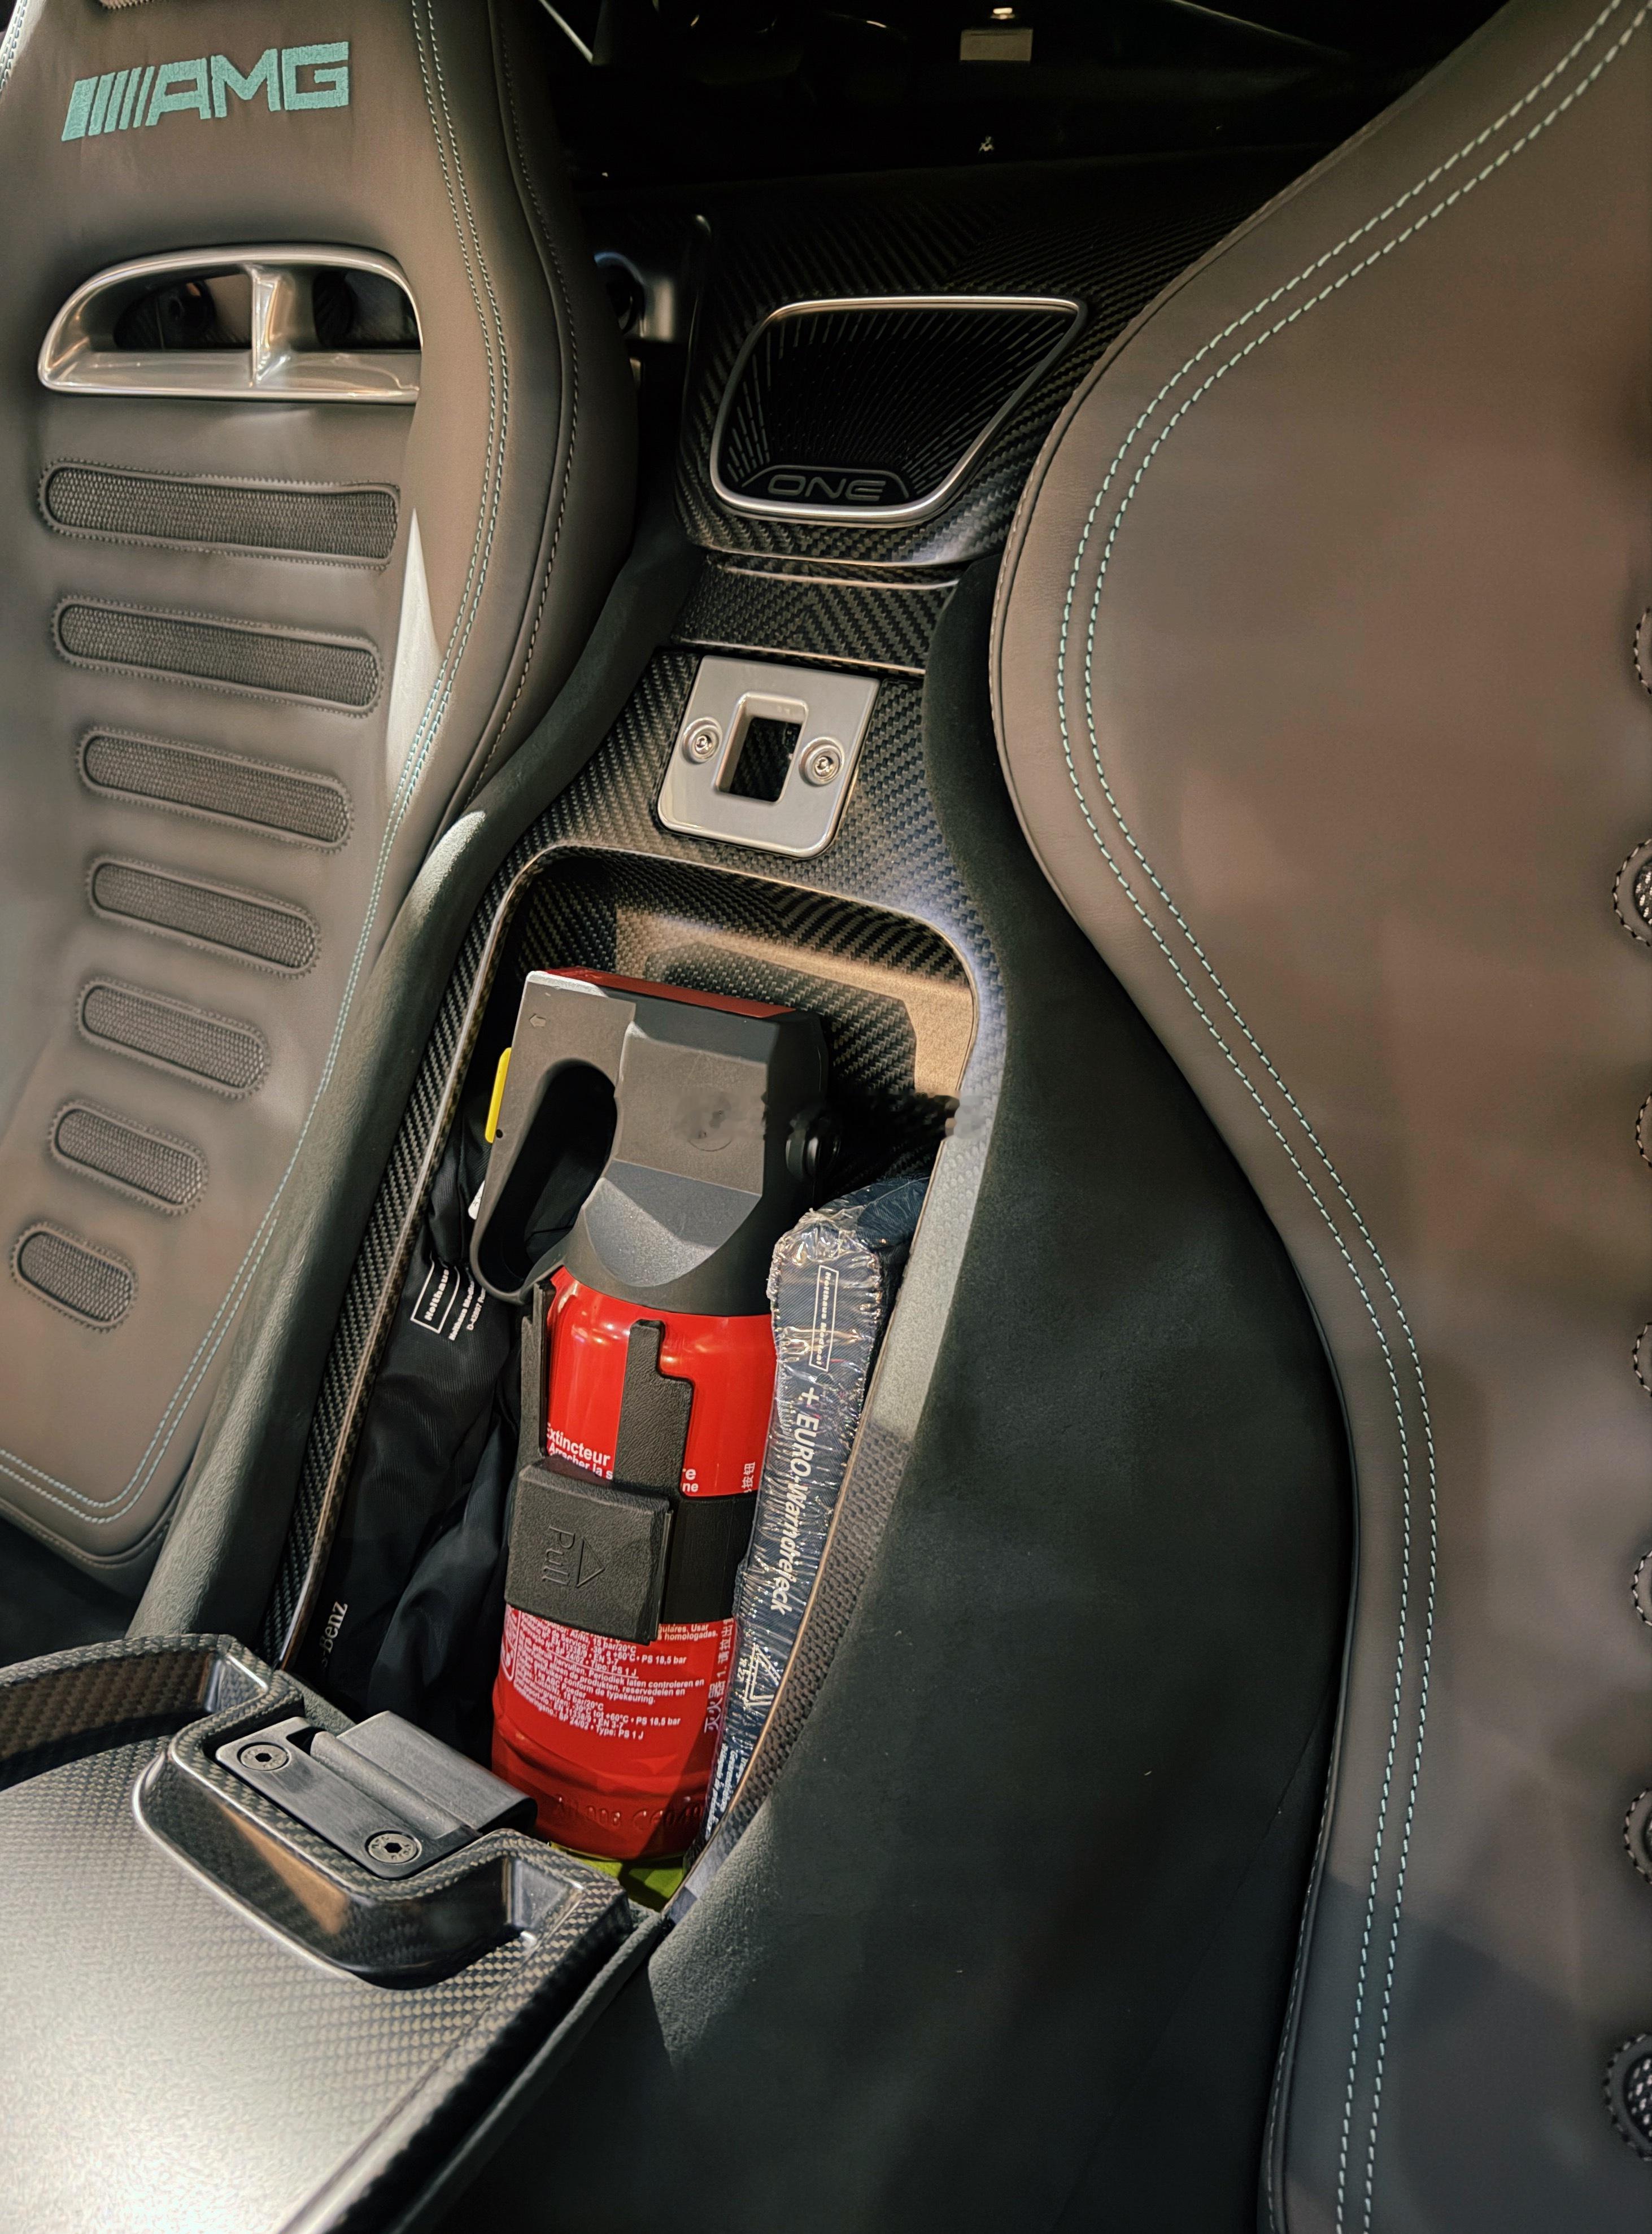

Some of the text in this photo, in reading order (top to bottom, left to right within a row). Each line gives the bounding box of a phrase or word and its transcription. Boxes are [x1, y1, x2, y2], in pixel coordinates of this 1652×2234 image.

[767, 474, 887, 501] ONE
[424, 1268, 450, 1321] Holthaus
[815, 1271, 832, 1365] Holthaus Medical
[770, 1413, 820, 1616] EURO-Warndreieck
[542, 1524, 576, 1586] Pull
[664, 1630, 718, 1642] homologadas.
[691, 1624, 709, 1632] Usar
[591, 1659, 609, 1672] Tipo:
[593, 1652, 605, 1664] EN
[606, 1656, 619, 1666] 3-7
[641, 1654, 653, 1664] PS
[655, 1655, 672, 1665] 18,5
[673, 1655, 687, 1664] bar
[569, 1671, 579, 1681] de
[579, 1675, 620, 1693] produkten,
[622, 1686, 675, 1697] reservedelen
[588, 1669, 625, 1686] Periodiek
[626, 1677, 647, 1688] laten
[648, 1679, 694, 1688] controleren
[561, 1682, 587, 1699] Poeder
[564, 1677, 594, 1694] conform
[595, 1686, 605, 1696] de
[606, 1689, 656, 1705] typekeuring.
[593, 1709, 604, 1718] tot
[635, 1716, 648, 1726] PS
[650, 1717, 666, 1727] 18,5
[667, 1717, 681, 1726] bar
[598, 1717, 610, 1728] EN
[596, 1725, 616, 1736] Type:
[618, 1729, 630, 1739] PS
[638, 1730, 644, 1740] J
